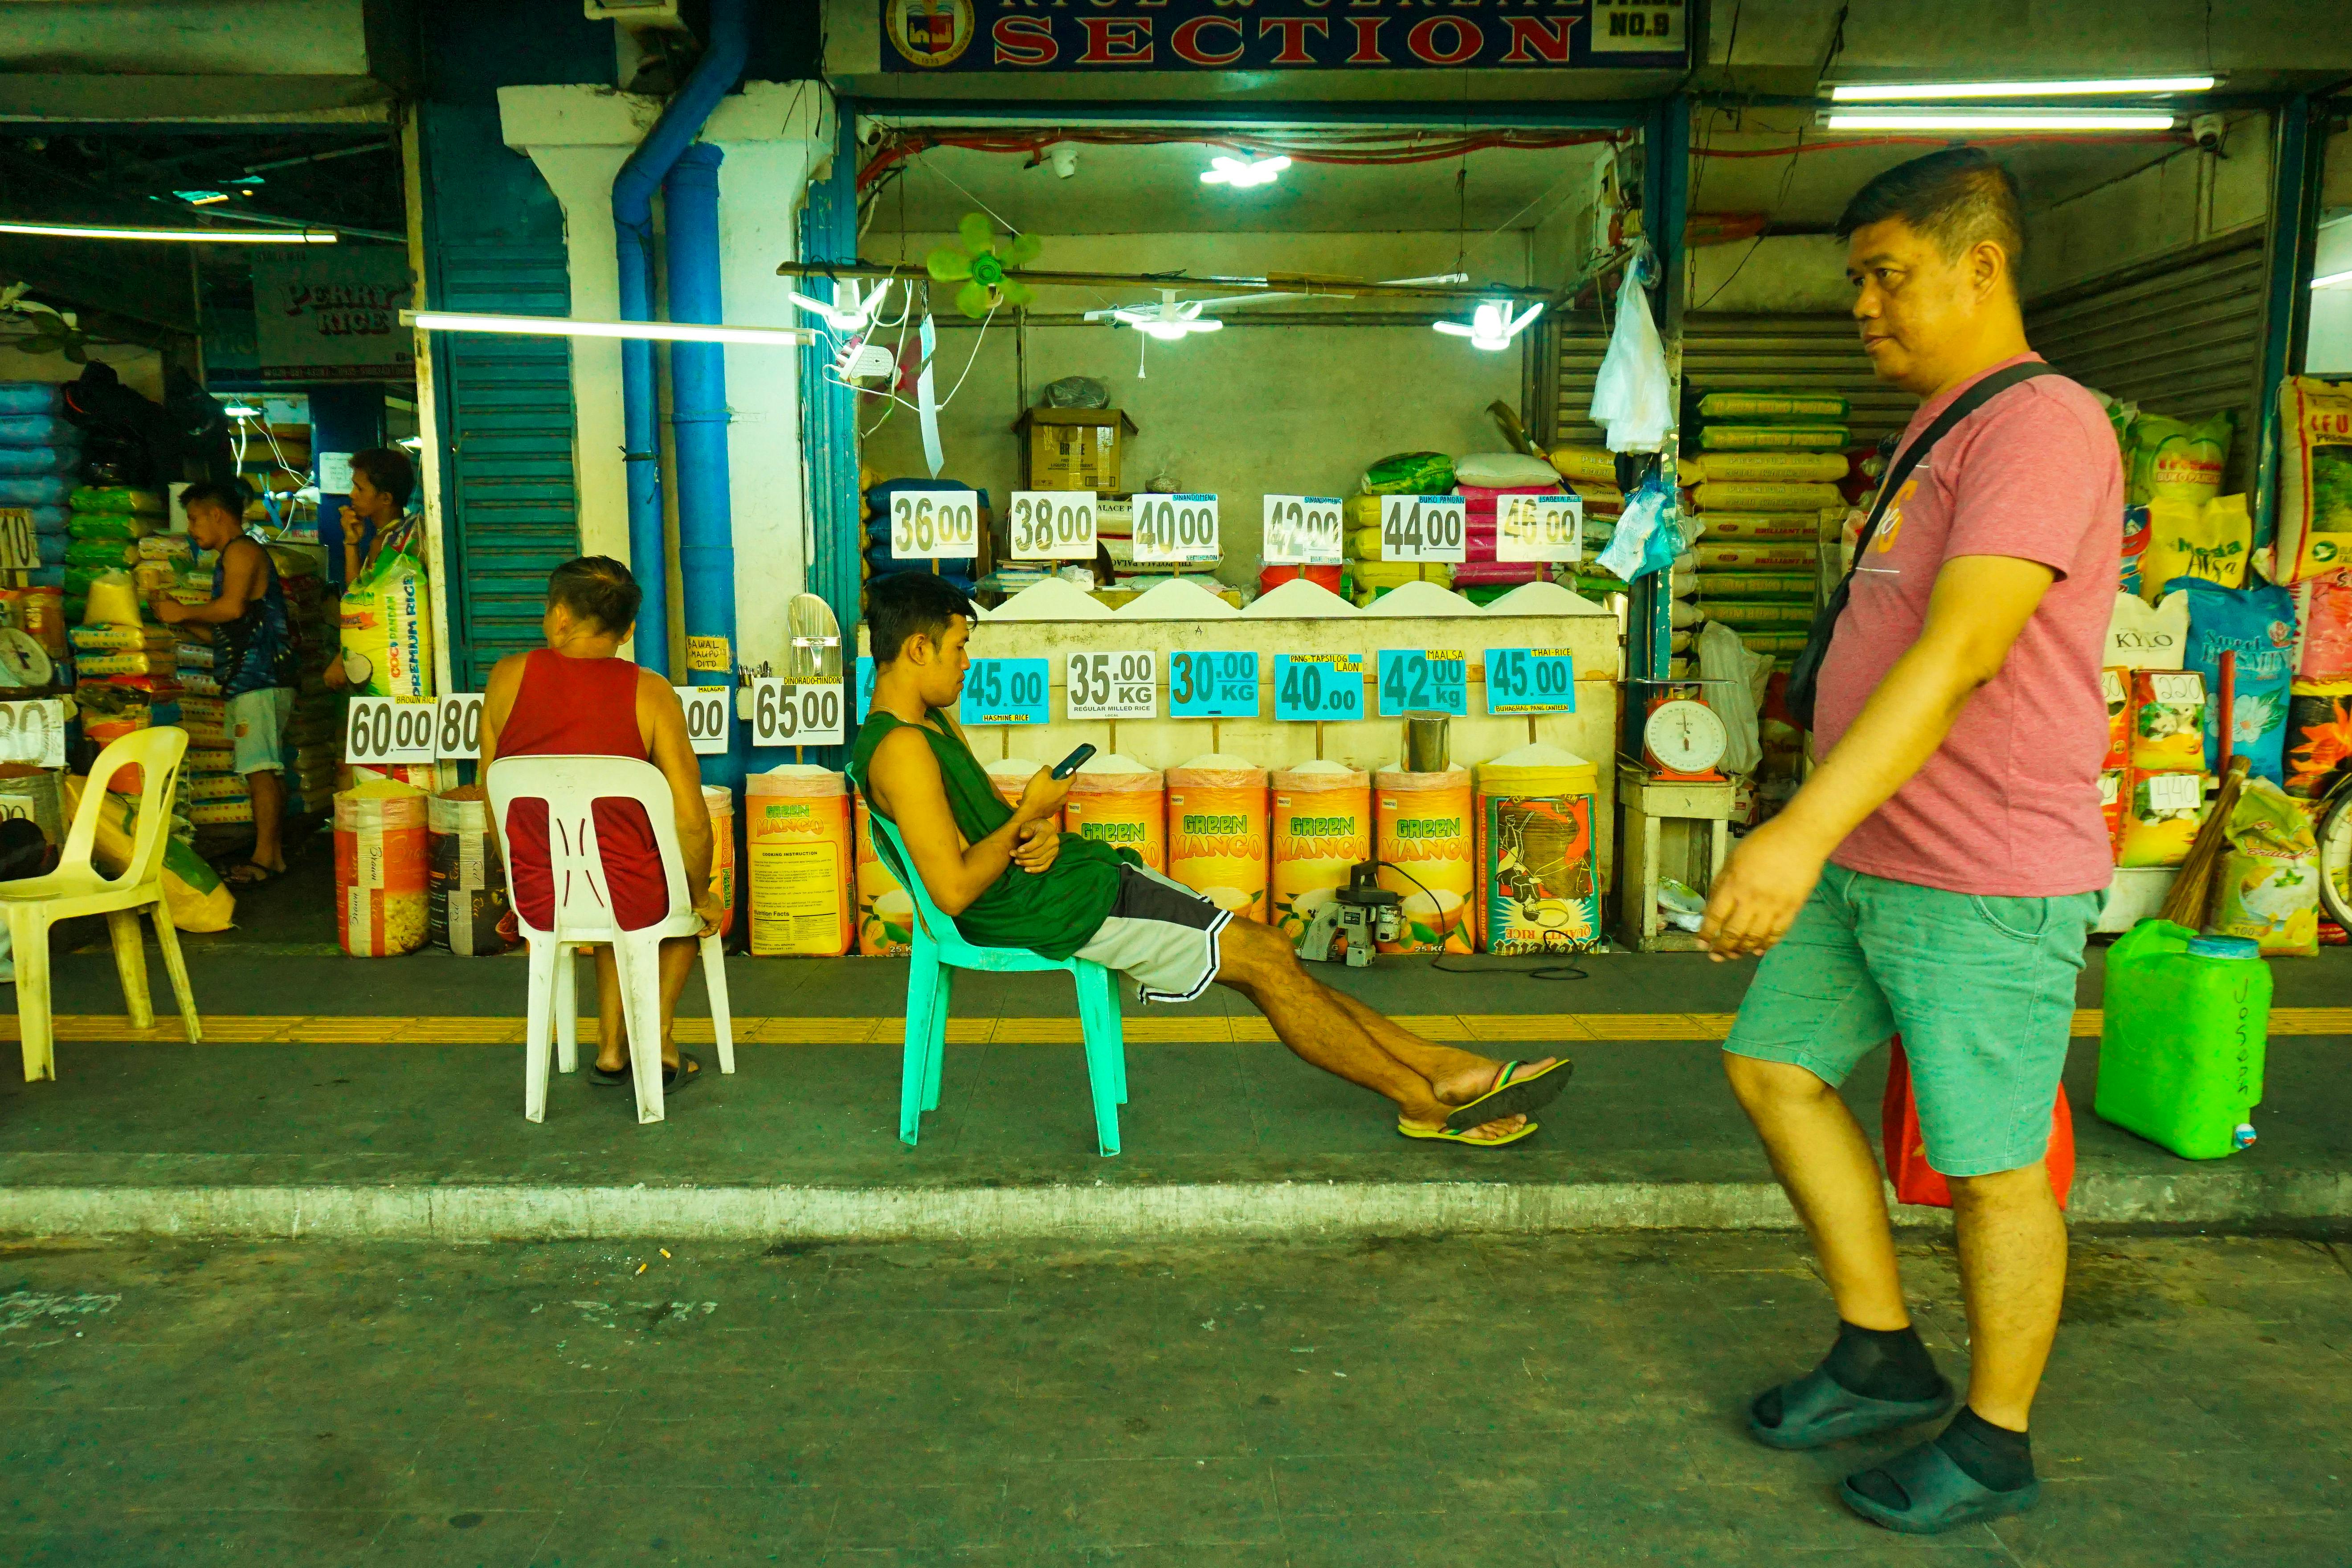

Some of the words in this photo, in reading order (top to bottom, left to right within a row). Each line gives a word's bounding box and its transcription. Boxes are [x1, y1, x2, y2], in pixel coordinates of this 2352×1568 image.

[1609, 12, 1669, 36] NO.9
[992, 15, 1583, 65] SECTION
[317, 310, 391, 335] RICE
[895, 497, 972, 552] 36.00
[1015, 498, 1091, 552] 38.00
[1137, 502, 1213, 554] 40.00
[1267, 502, 1338, 556] 42.00
[1385, 502, 1460, 555] 44.00
[403, 576, 416, 616] RICE
[687, 639, 719, 649] BAWAL
[2115, 633, 2173, 648] KYLO
[407, 620, 421, 696] PREMIUM
[1336, 662, 1359, 672] LAON
[1427, 650, 1464, 660] MAALSA
[967, 662, 1041, 707] 45.00
[1494, 651, 1568, 696] 45.00
[1119, 687, 1152, 703] KG
[1221, 685, 1254, 701] KG
[1282, 665, 1355, 711] 40.00
[1436, 686, 1460, 707] kg
[2159, 676, 2201, 699] 220
[757, 684, 838, 739] 65.00
[351, 703, 431, 757] 60.00
[2158, 776, 2196, 806] 440
[766, 805, 810, 818] GREEN
[755, 817, 824, 838] MANGO
[1082, 822, 1145, 842] GREEN
[1183, 815, 1247, 834] GREEN
[1290, 816, 1355, 837] GREEN
[1397, 817, 1461, 838] GREEN
[1170, 833, 1263, 864] MANGO
[1276, 835, 1368, 864] MANGO
[1382, 835, 1471, 863] MANGO
[1481, 886, 1487, 901] 5%
[1505, 928, 1536, 939] RICE
[1540, 924, 1591, 940] QUALITY
